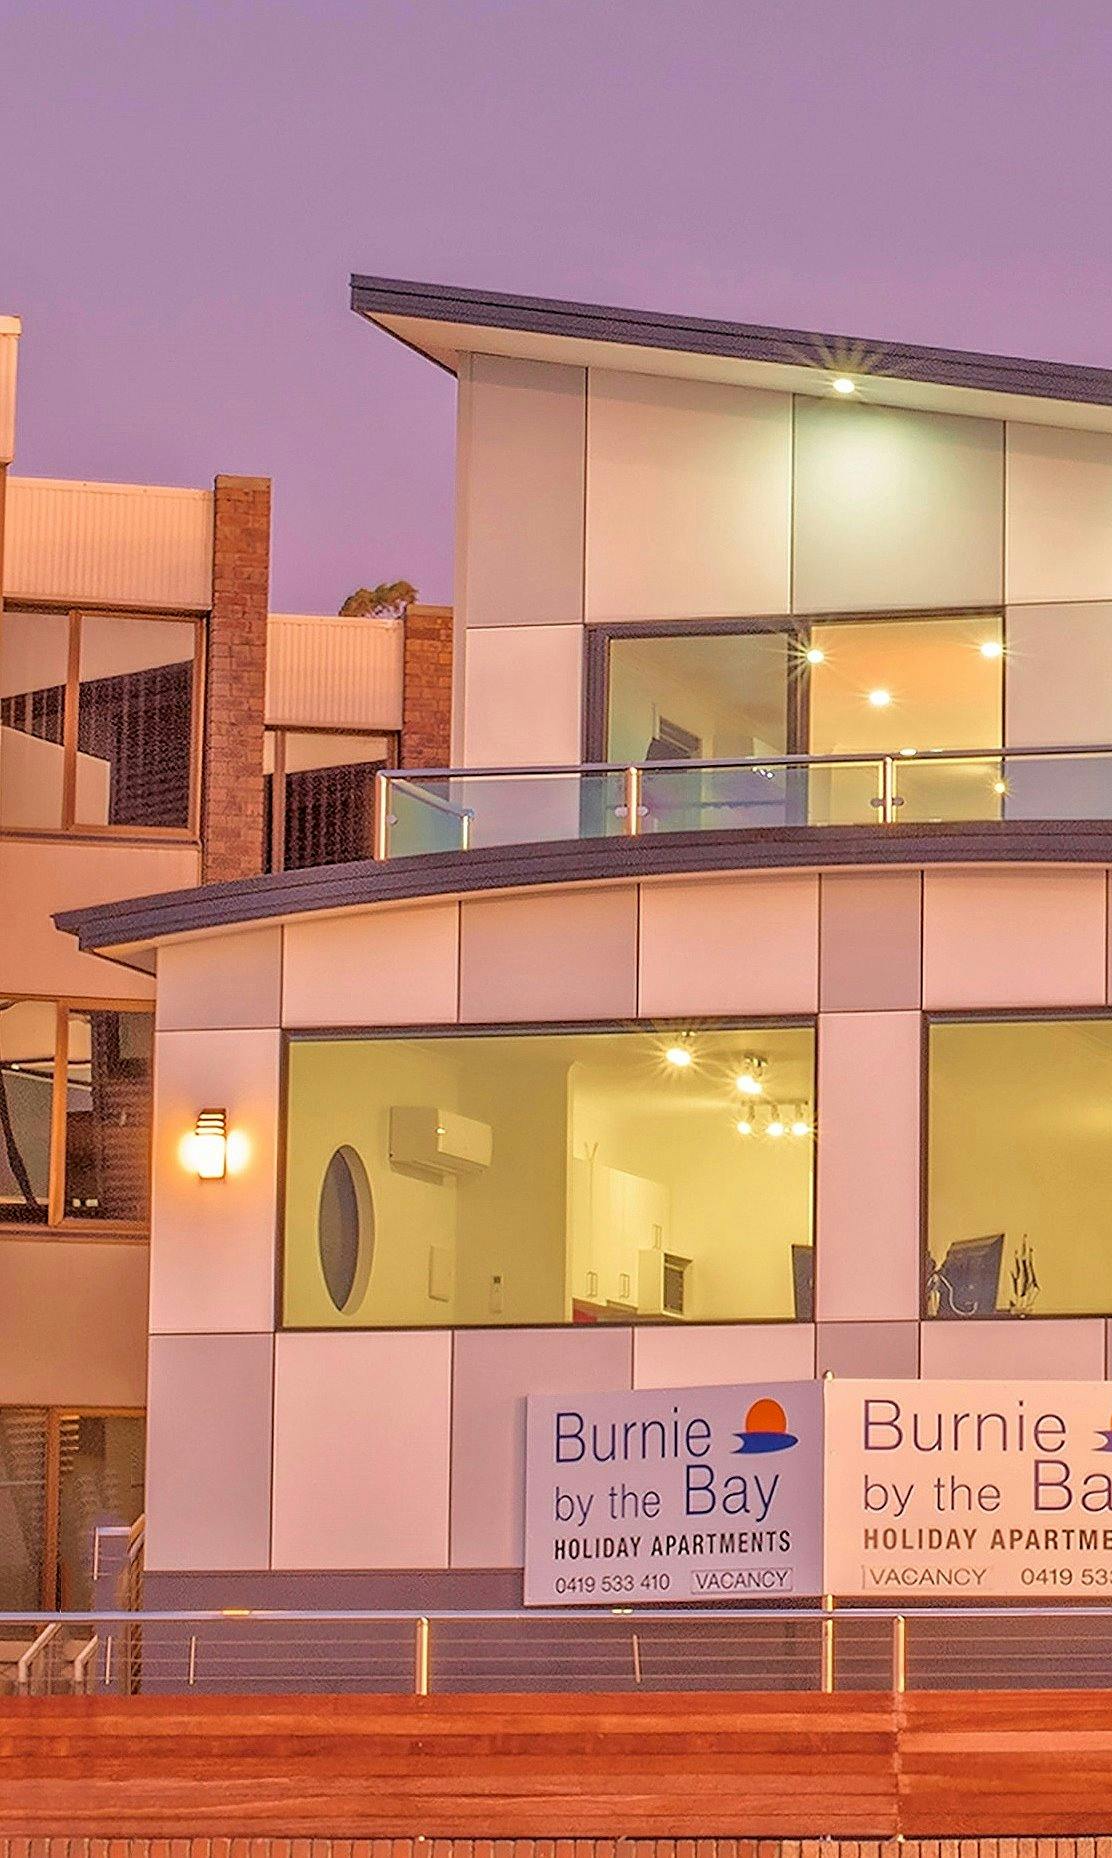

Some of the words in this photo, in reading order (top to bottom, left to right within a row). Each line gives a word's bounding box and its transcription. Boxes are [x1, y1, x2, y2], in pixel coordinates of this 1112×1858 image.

[555, 1406, 711, 1463] Burnie
[863, 1399, 1067, 1453] Burnie
[555, 1486, 594, 1527] by
[609, 1483, 661, 1519] the
[686, 1464, 779, 1522] Bay
[864, 1474, 914, 1517] by
[934, 1475, 1001, 1511] the
[554, 1536, 642, 1560] HOLIDAY
[651, 1530, 791, 1557] APARTMENTS
[864, 1528, 977, 1550] HOLIDAY
[555, 1576, 595, 1594] 0419
[601, 1575, 635, 1592] 533
[640, 1573, 670, 1591] 410
[696, 1571, 788, 1590] VACANCY
[870, 1568, 987, 1586] VACANCY
[1021, 1568, 1073, 1586] 0419
